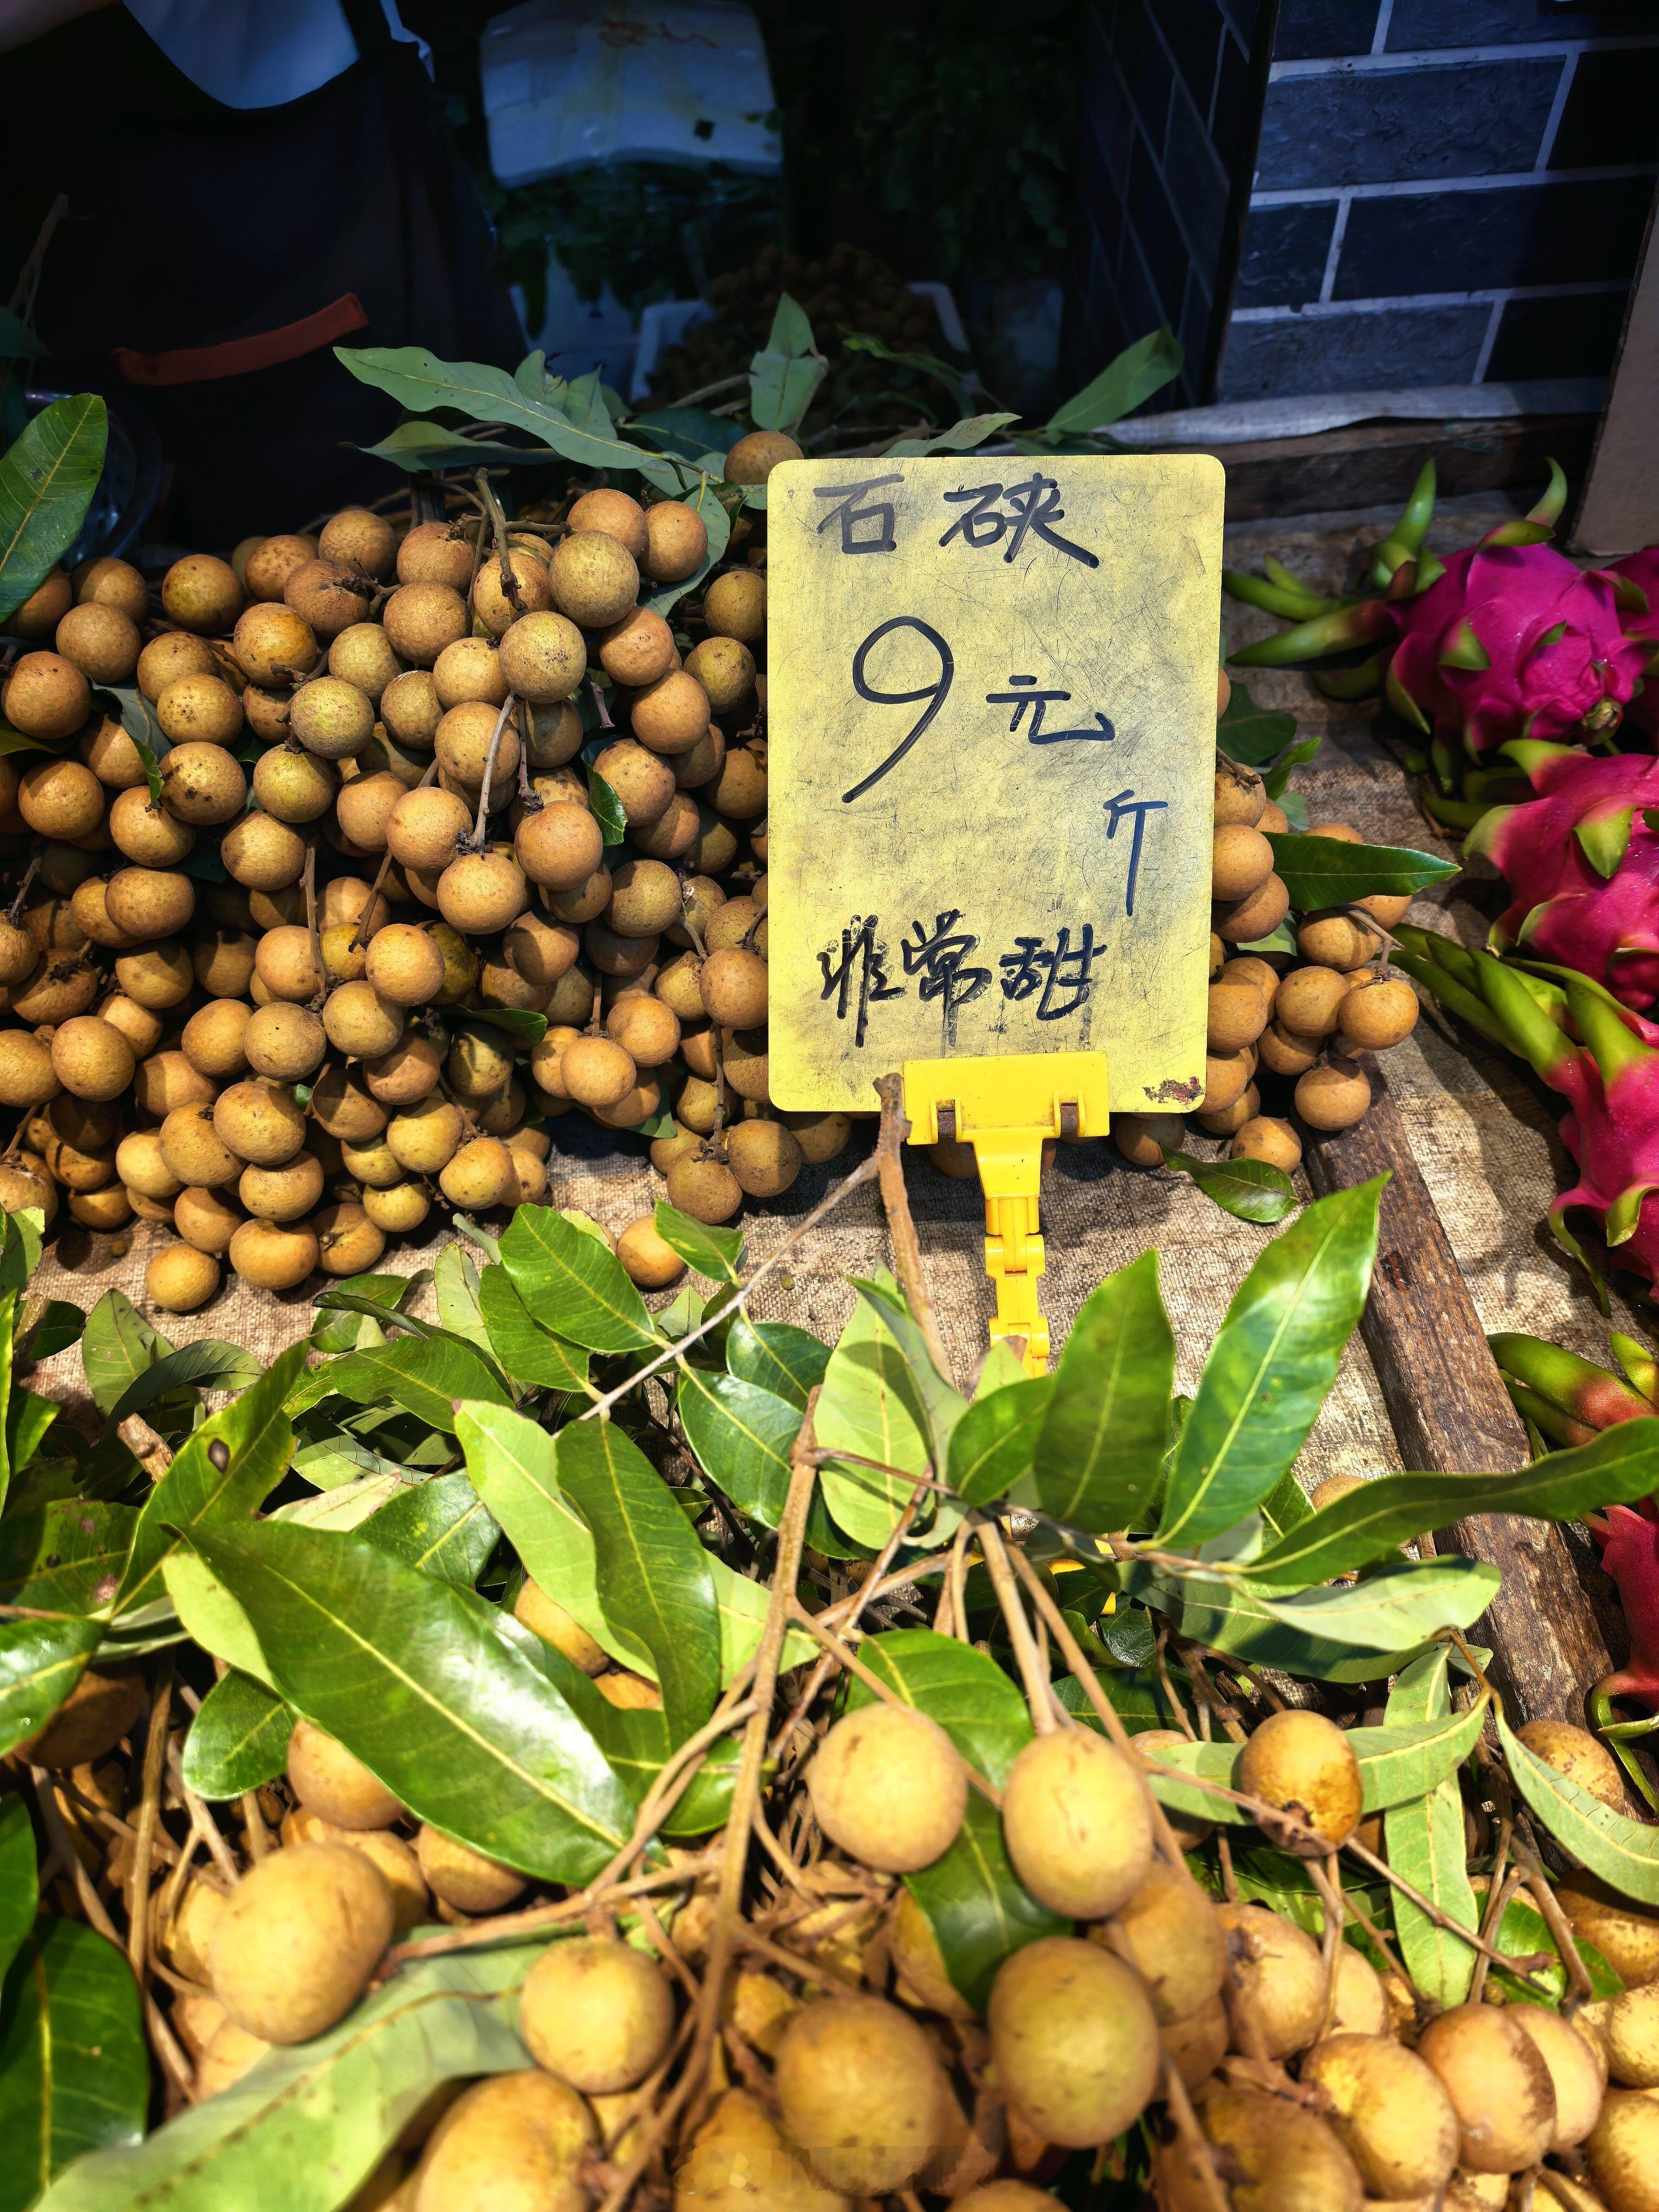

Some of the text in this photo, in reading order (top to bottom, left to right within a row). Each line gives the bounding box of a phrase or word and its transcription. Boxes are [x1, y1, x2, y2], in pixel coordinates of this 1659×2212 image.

[1102, 789, 1169, 917] 斤
[816, 908, 1108, 1049] 非常甜
